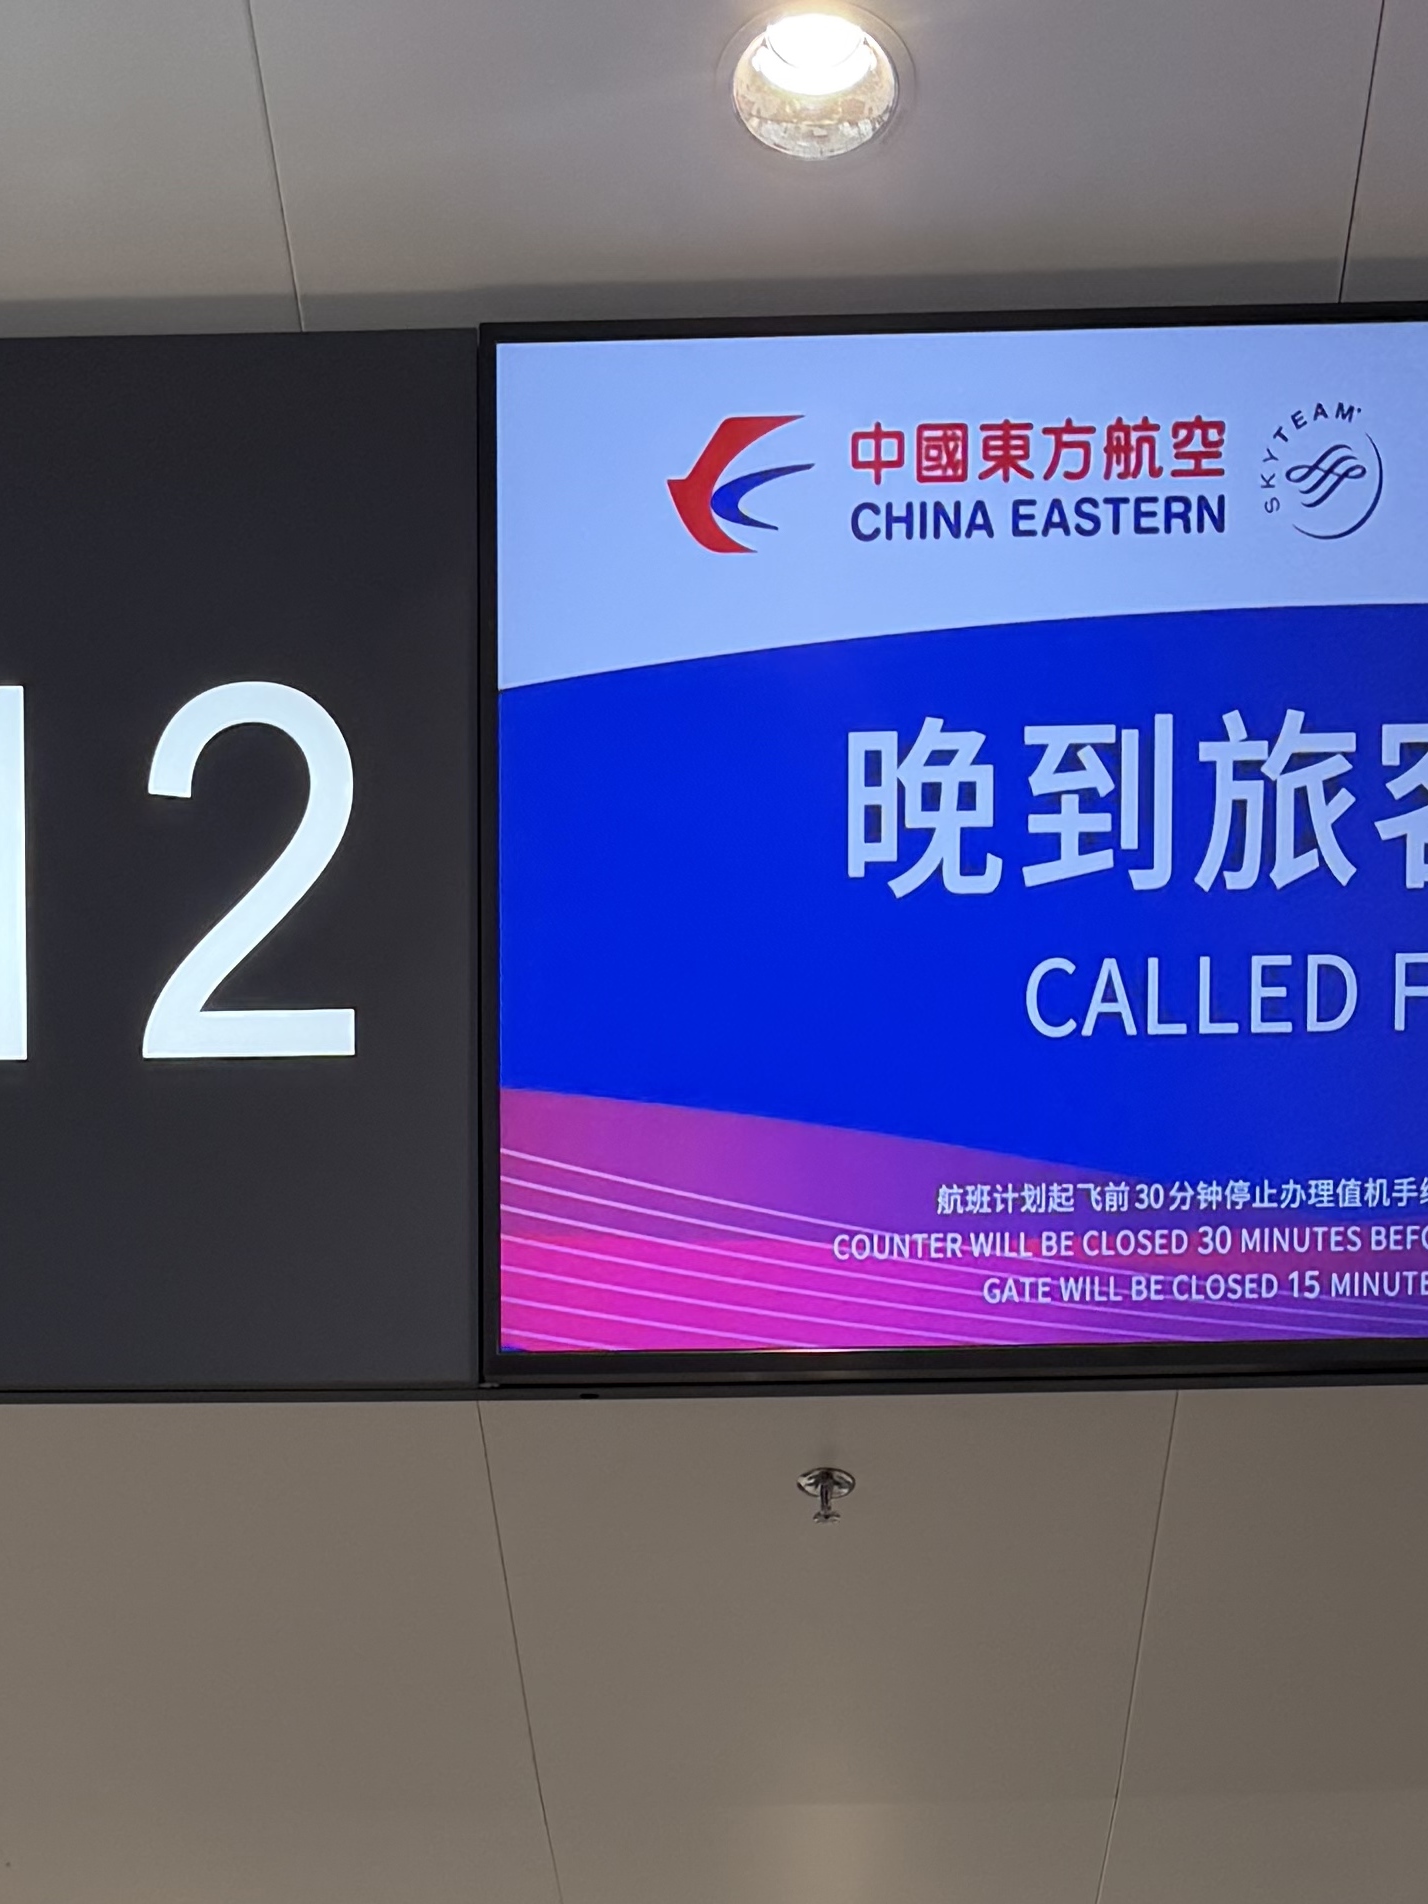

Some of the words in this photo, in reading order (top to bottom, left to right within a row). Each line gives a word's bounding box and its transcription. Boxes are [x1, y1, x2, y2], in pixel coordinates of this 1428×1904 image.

[851, 415, 1226, 486] 中國東方航空
[1260, 402, 1356, 514] SKYTEAM
[850, 500, 995, 542] CHINA
[1011, 494, 1226, 537] EASTERN
[1024, 951, 1359, 1039] CALLED
[833, 1233, 963, 1260] COUNTER
[970, 1232, 1033, 1259] WILL
[1040, 1231, 1075, 1258] BE
[1082, 1228, 1189, 1257] CLOSED
[1197, 1226, 1232, 1255] 30
[1240, 1226, 1362, 1254] MINUTES
[983, 1276, 1053, 1304] GATE
[1059, 1275, 1123, 1302] WILL
[1130, 1275, 1165, 1301] BE
[1172, 1272, 1279, 1301] CLOSED
[1287, 1270, 1321, 1299] 15
